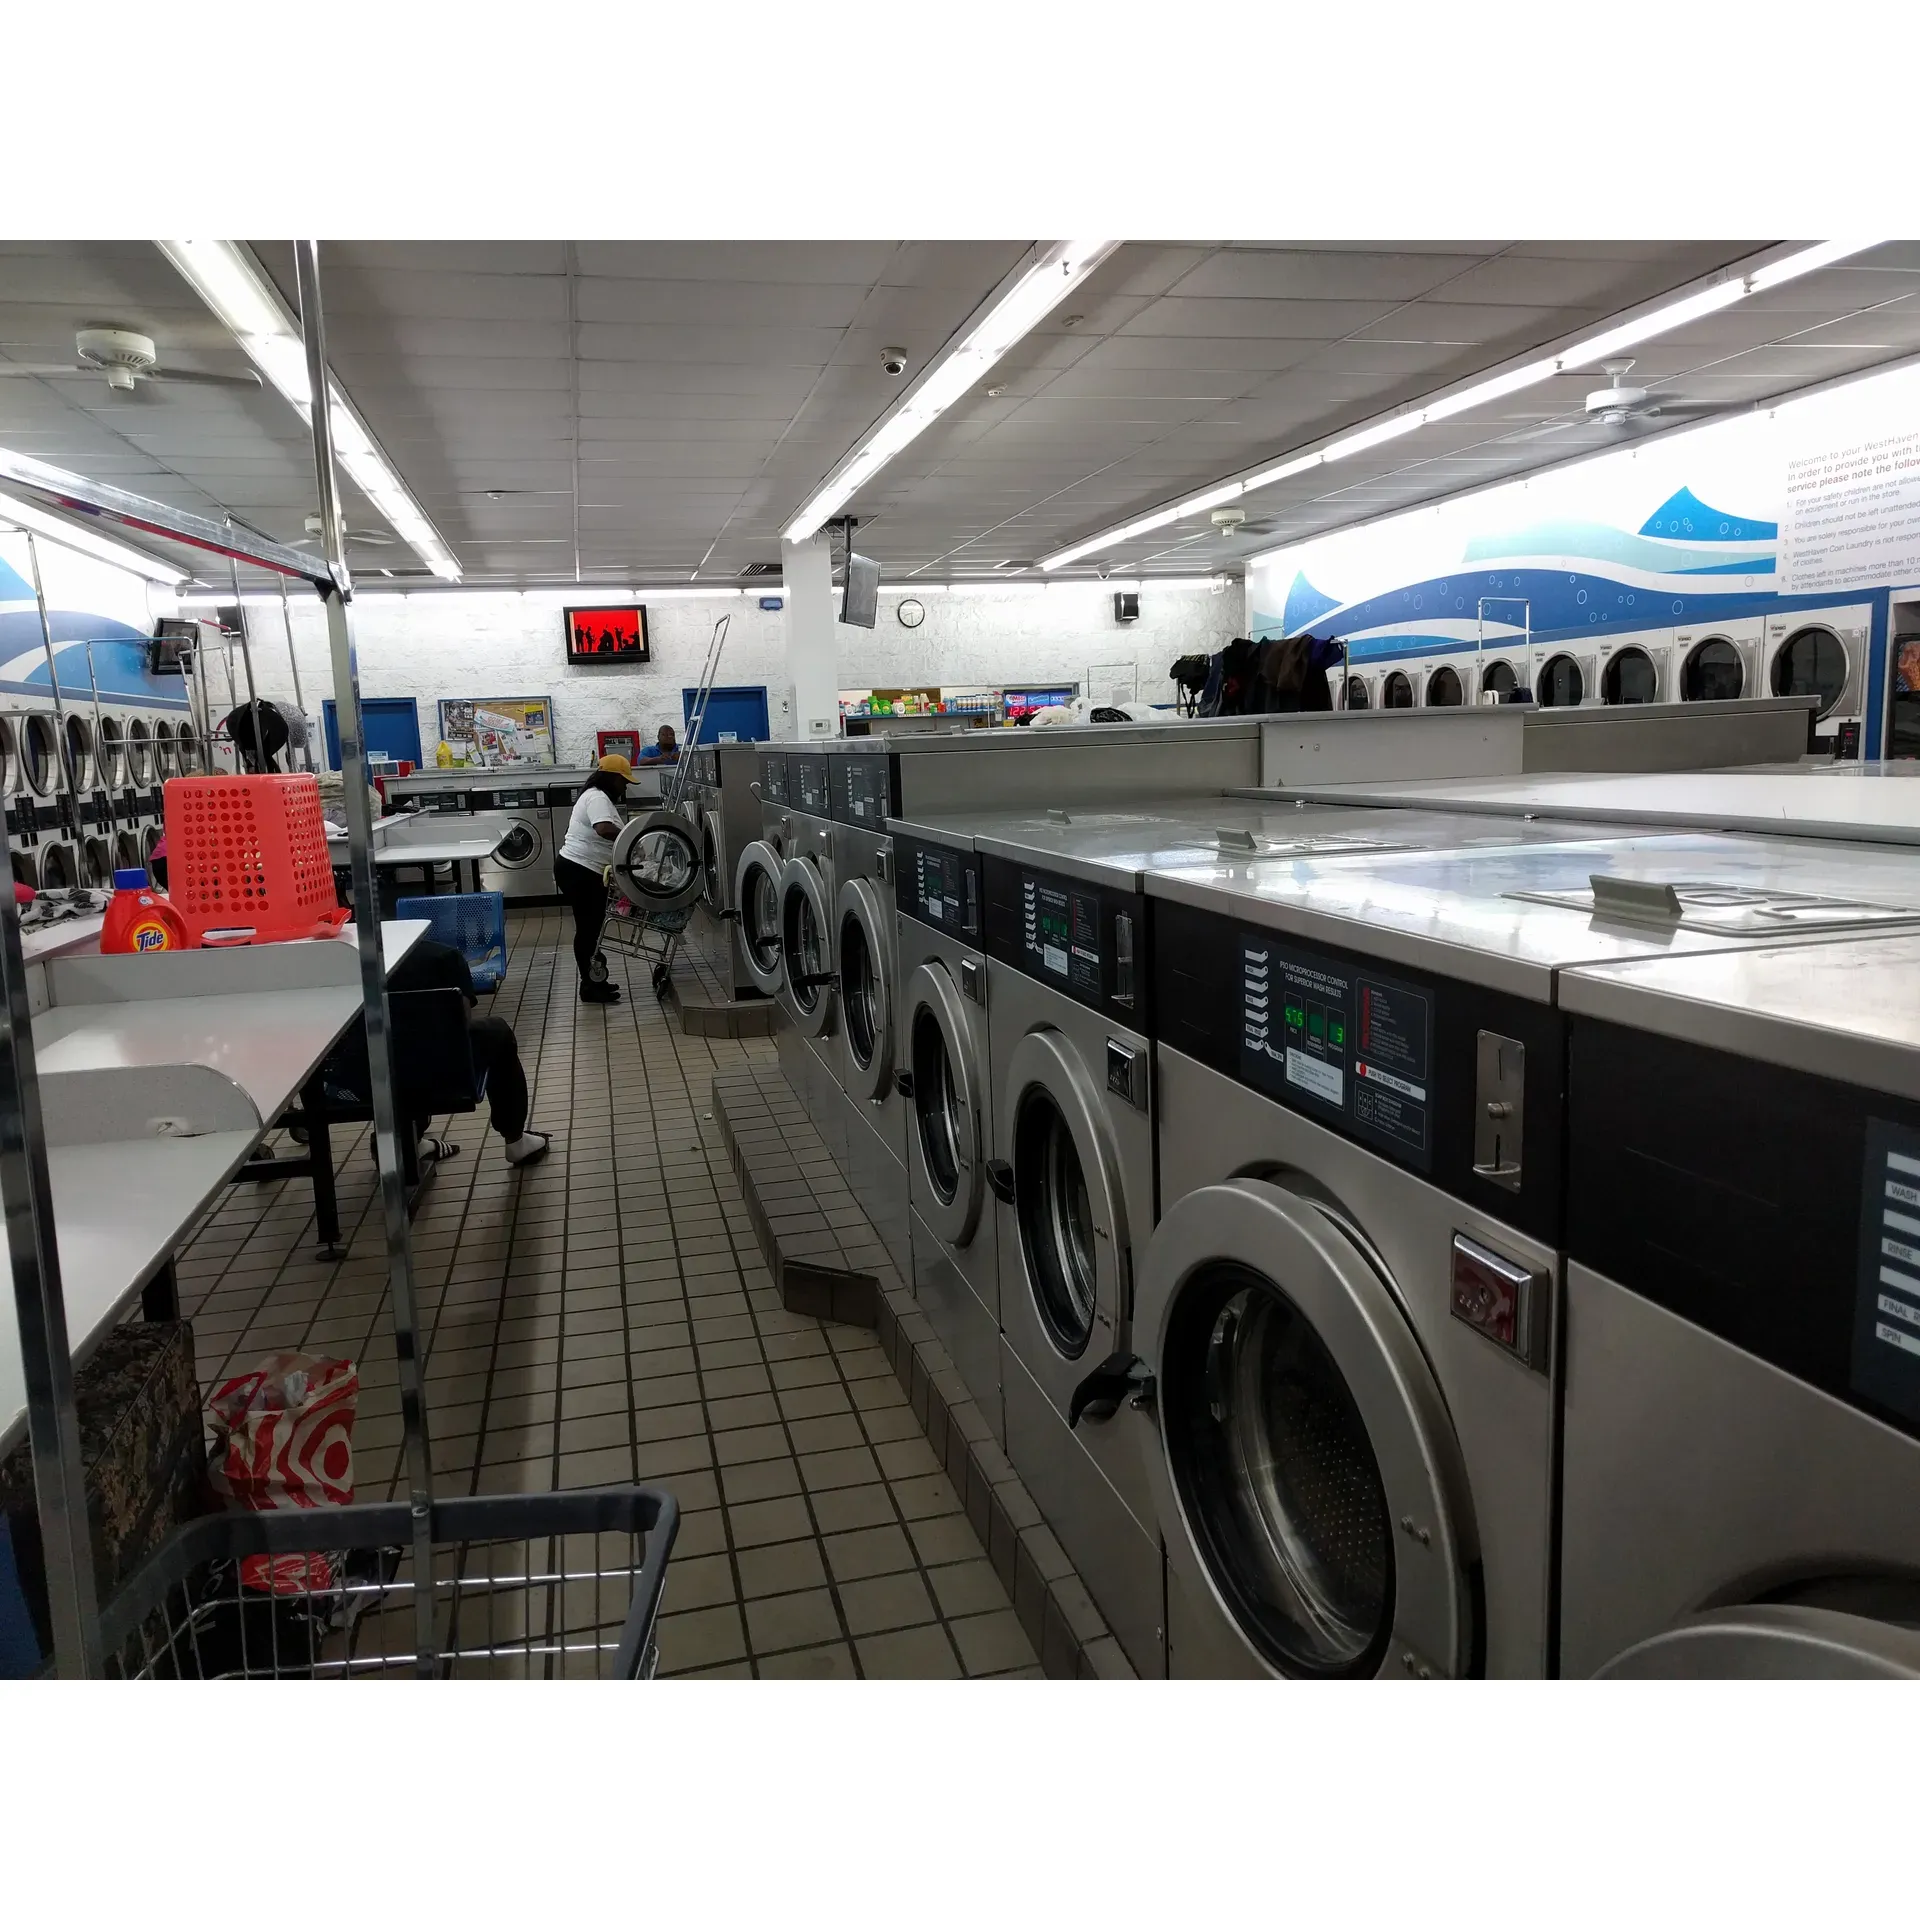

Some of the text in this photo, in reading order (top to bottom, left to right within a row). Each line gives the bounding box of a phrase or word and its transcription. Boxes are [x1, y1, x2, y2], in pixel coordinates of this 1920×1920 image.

[1788, 432, 1918, 469] Welcome to your WestHaven
[1788, 473, 1796, 481] In
[1798, 468, 1820, 479] order
[1823, 464, 1832, 473] to
[1835, 457, 1868, 472] provide
[1871, 452, 1888, 464] you
[1891, 446, 1912, 457] with
[1787, 480, 1817, 493] service
[1819, 474, 1849, 488] please
[1851, 468, 1873, 480] note
[1876, 464, 1891, 474] the
[1796, 498, 1806, 507] For
[1807, 496, 1821, 506] your
[1823, 491, 1843, 501] safety
[1844, 485, 1871, 497] children
[1885, 480, 1897, 488] not
[1795, 518, 1820, 530] Children
[1822, 514, 1843, 525] should
[1845, 511, 1856, 520] not
[1858, 509, 1866, 517] be
[1868, 507, 1879, 515] left
[1805, 500, 1839, 513] equipment
[1794, 535, 1806, 543] You
[1807, 533, 1817, 541] are
[1818, 529, 1837, 540] solely
[1838, 523, 1877, 536] responsible
[1878, 520, 1888, 529] for
[1889, 518, 1905, 530] your
[1793, 545, 1828, 558] WestHaven
[1829, 543, 1845, 553] Coin
[1846, 537, 1874, 550] Laundry
[1882, 534, 1894, 542] not
[1791, 571, 1815, 581] Clothes
[1816, 569, 1827, 578] left
[1835, 564, 1867, 575] machines
[1868, 561, 1887, 570] more
[1888, 558, 1904, 567] than
[1906, 555, 1915, 564] 10
[1791, 581, 1799, 590] by
[1800, 576, 1834, 588] attendants
[1843, 568, 1892, 583] accommodate
[1893, 565, 1912, 576] other
[136, 928, 164, 952] Tide
[1289, 963, 1327, 982] MICROPROCESSOR
[1326, 975, 1348, 990] CONTROL
[1293, 975, 1313, 989] SUPERIOR
[1312, 981, 1325, 993] WASH
[1325, 985, 1342, 998] RESULTS
[1891, 1184, 1917, 1201] WASH
[1887, 1242, 1913, 1260] RINSE
[1884, 1299, 1908, 1318] FINAL
[1882, 1327, 1901, 1345] SPIN
